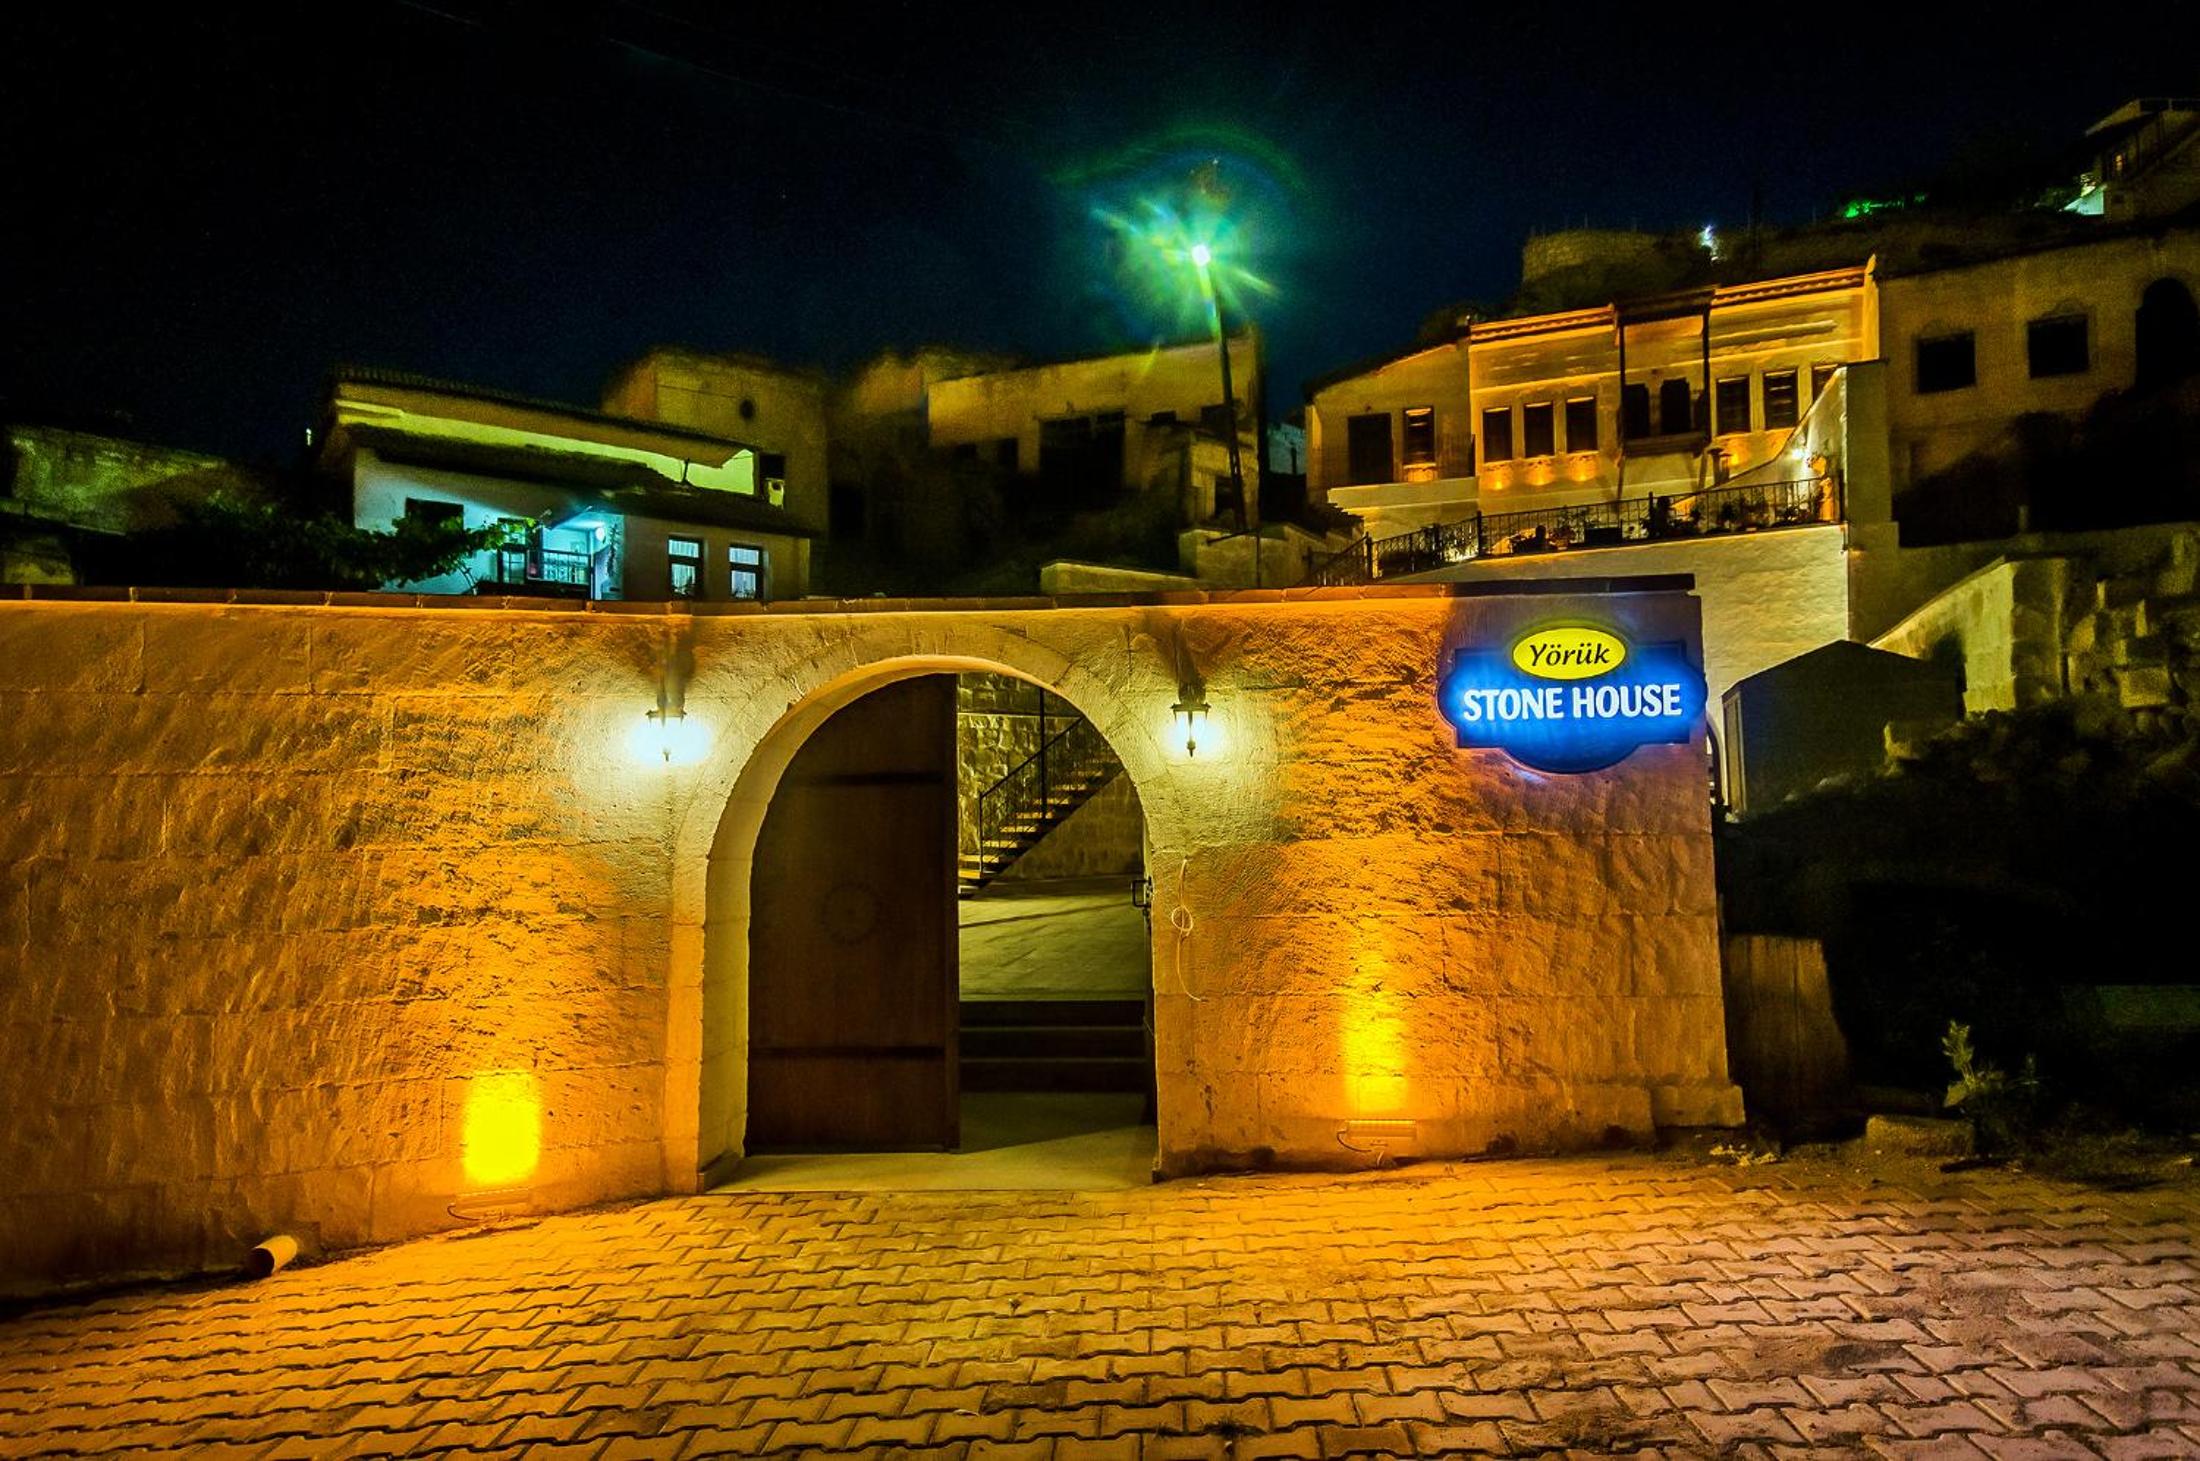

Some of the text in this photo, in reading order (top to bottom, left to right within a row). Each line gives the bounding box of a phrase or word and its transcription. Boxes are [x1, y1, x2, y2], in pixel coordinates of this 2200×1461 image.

[1530, 642, 1610, 666] Yörük
[1463, 683, 1682, 721] STONE HOUSE
